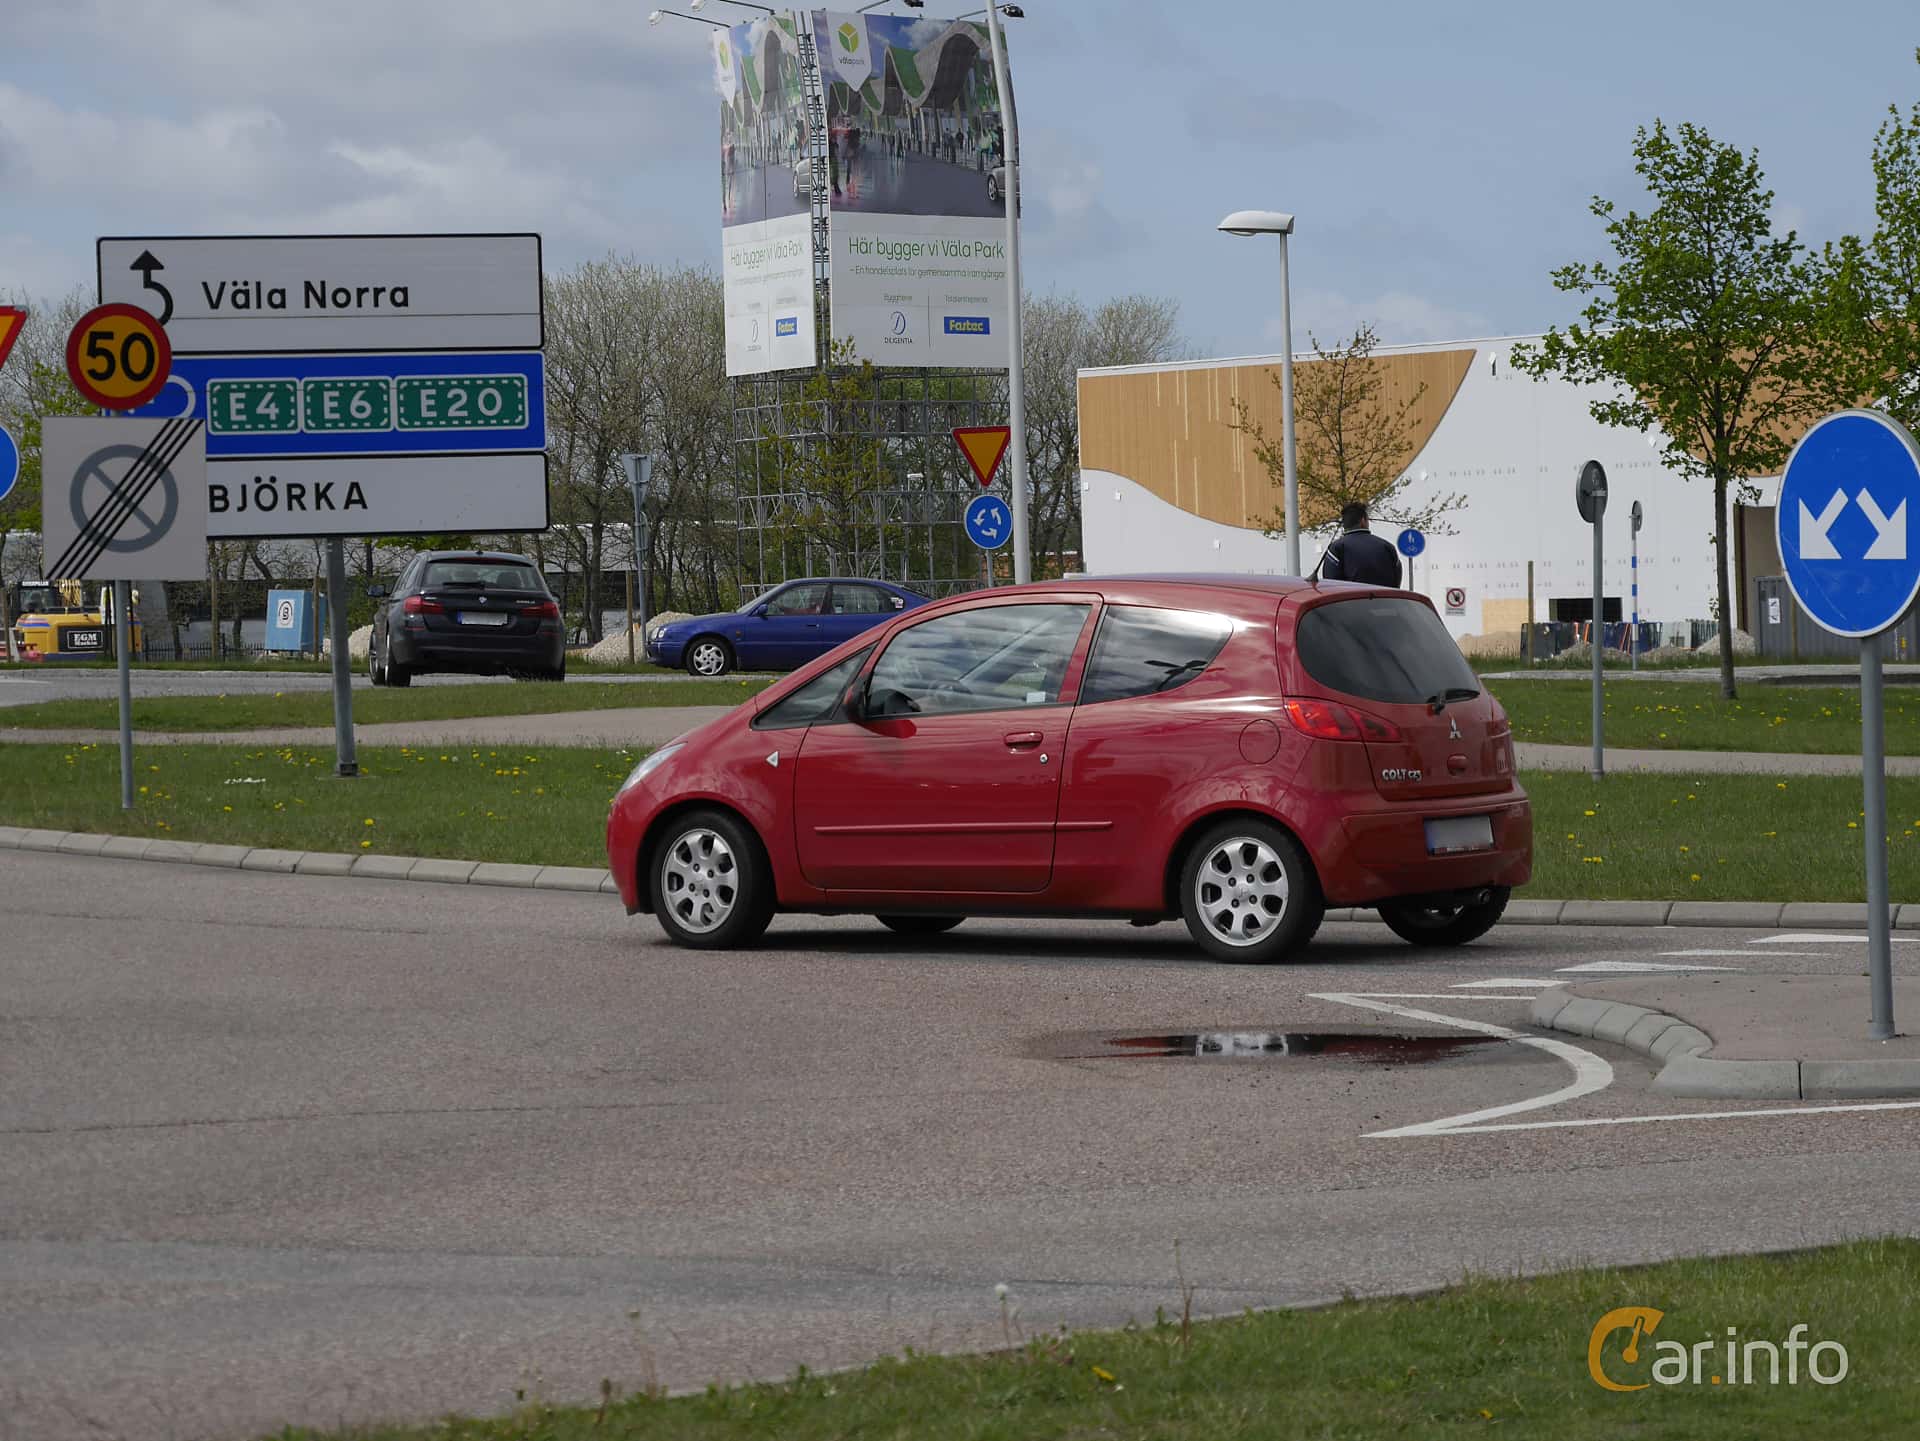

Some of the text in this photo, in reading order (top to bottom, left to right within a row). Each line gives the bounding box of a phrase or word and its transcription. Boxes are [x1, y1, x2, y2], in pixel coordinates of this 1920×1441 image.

[849, 236, 1004, 261] Här bygger vi Väla Park
[201, 280, 409, 310] Väla Norra
[87, 331, 155, 381] 50
[420, 388, 503, 418] E20
[208, 476, 369, 513] BJÖRKA
[1382, 768, 1407, 781] COLT
